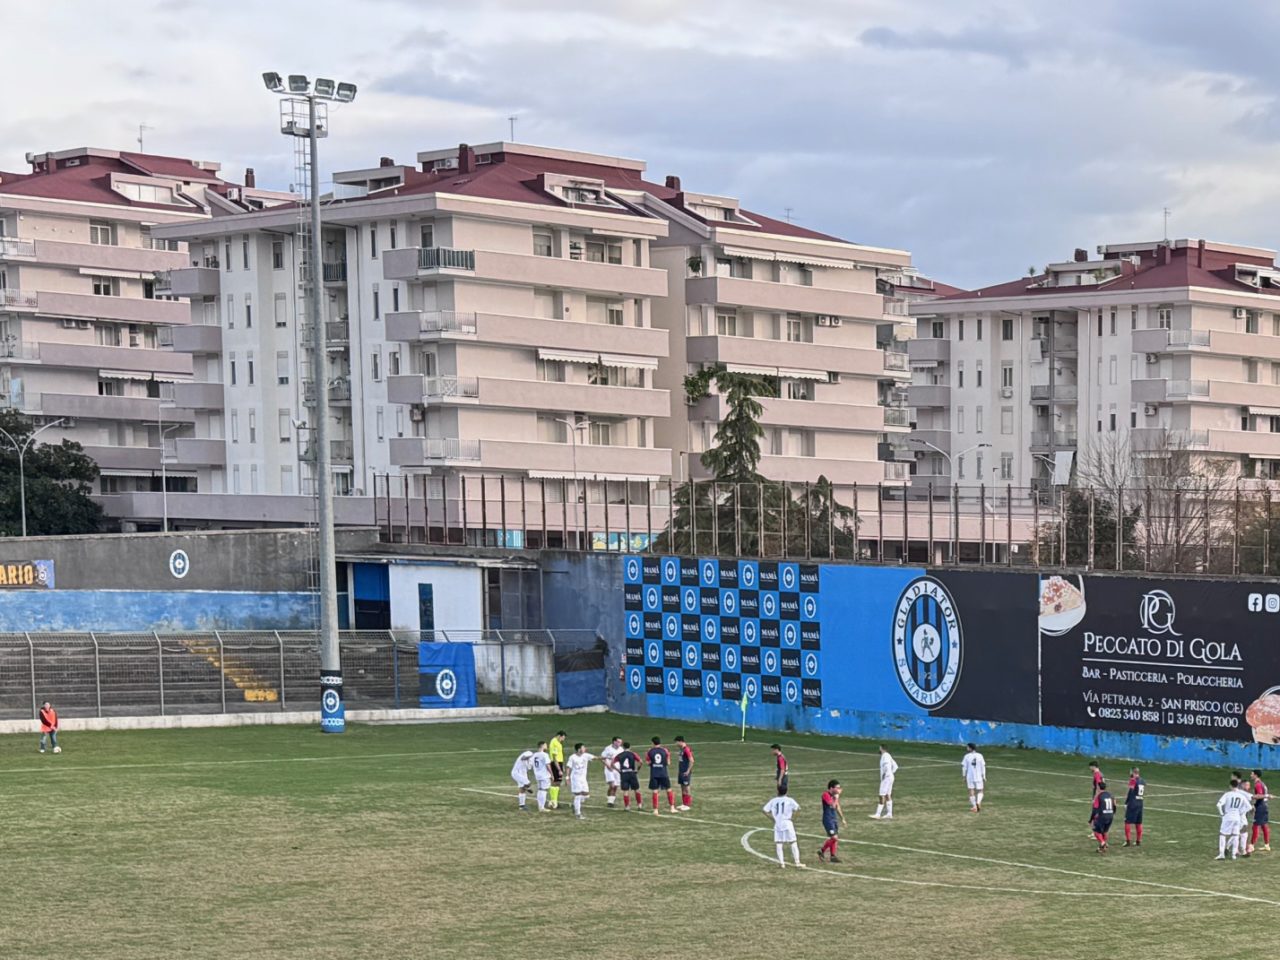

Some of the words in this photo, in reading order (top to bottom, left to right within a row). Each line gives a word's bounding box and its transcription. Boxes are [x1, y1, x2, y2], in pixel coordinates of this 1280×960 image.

[896, 582, 956, 630] GLADIATOR
[1083, 632, 1161, 657] PECCATO
[1166, 640, 1184, 658] DI
[1190, 638, 1243, 664] GOLA
[1082, 666, 1101, 679] BAR
[1109, 667, 1168, 684] PASTICCERIA
[1177, 672, 1244, 689] POLACCHERIA
[905, 677, 942, 704] MARIA
[1147, 698, 1154, 708] 2
[1161, 697, 1182, 710] SAN
[1184, 699, 1221, 712] PRISCO
[1222, 701, 1244, 715] (CE)
[1098, 707, 1122, 719] 0823
[1123, 709, 1141, 721] 340
[1142, 710, 1160, 722] 858
[1176, 713, 1194, 725] 349
[1196, 715, 1211, 727] 671
[1213, 716, 1239, 729] 7000
[654, 753, 662, 764] 9
[775, 801, 785, 815] 11
[1104, 798, 1113, 810] 11
[1230, 797, 1241, 809] 10
